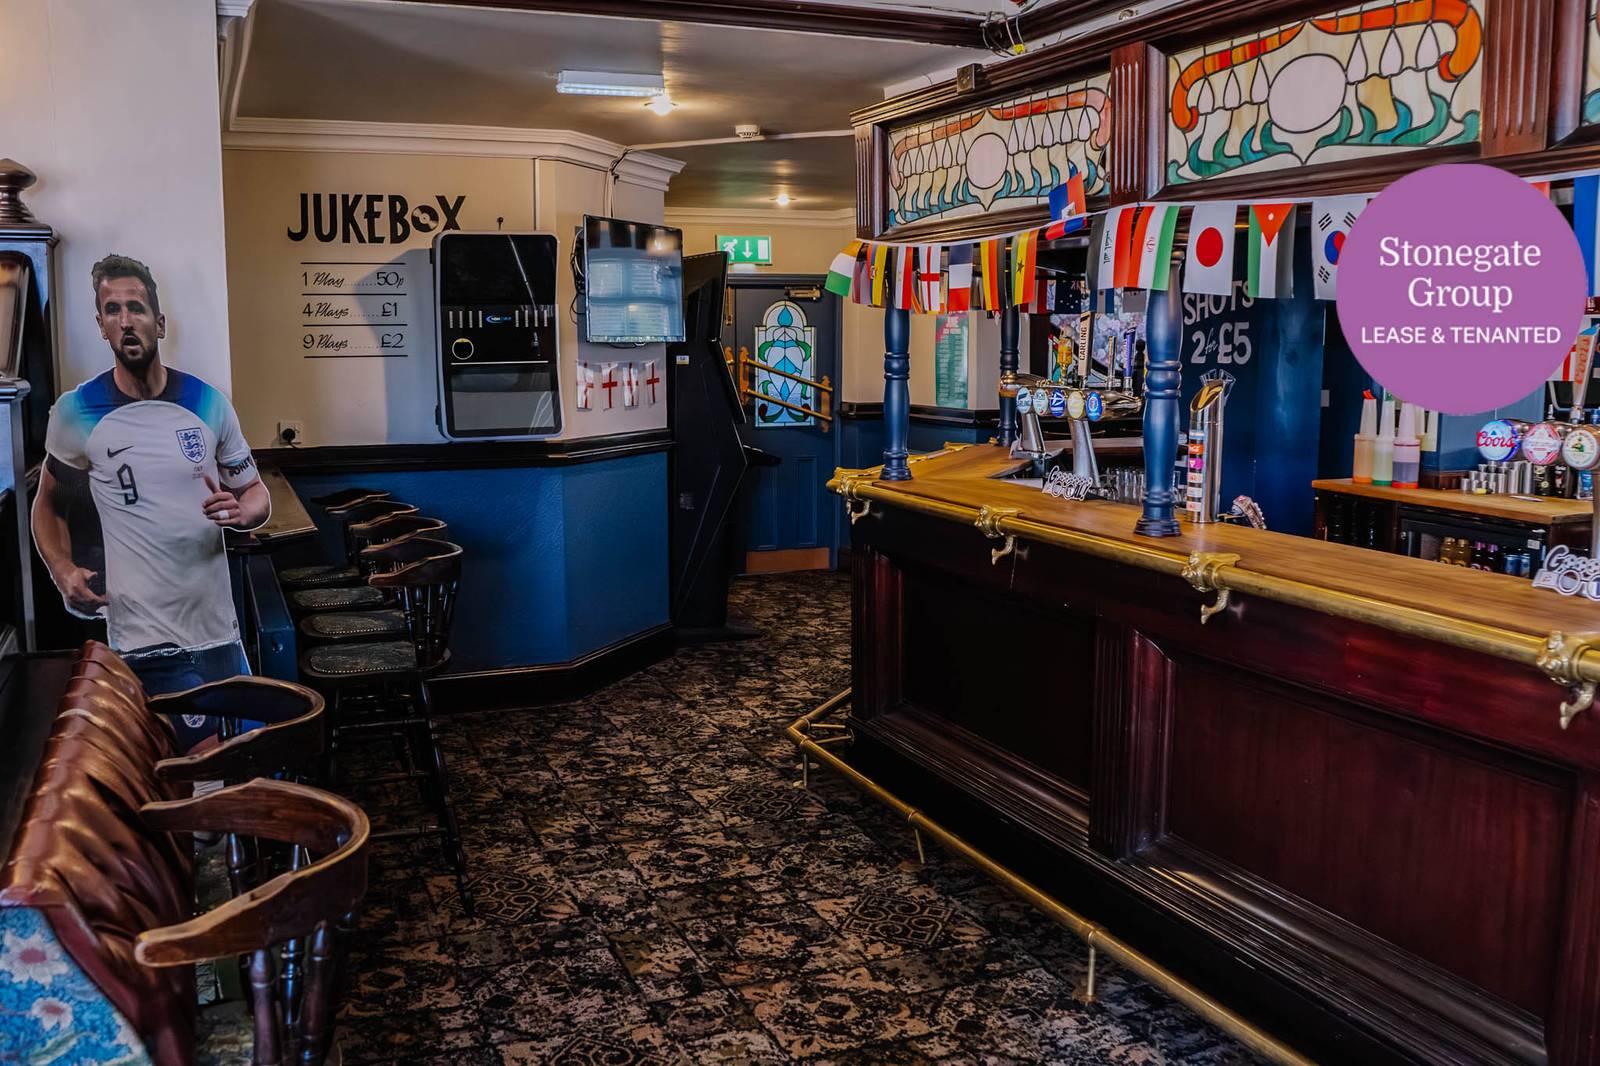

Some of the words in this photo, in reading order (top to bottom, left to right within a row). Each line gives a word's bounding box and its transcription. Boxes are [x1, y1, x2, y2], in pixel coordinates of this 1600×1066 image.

[287, 193, 466, 244] JUKEBOX
[302, 271, 309, 286] 1
[312, 271, 345, 288] Play
[376, 271, 404, 289] 50p
[302, 302, 313, 317] 4
[314, 302, 349, 319] Plays
[381, 302, 398, 317] £1
[1183, 280, 1254, 325] SHOTS
[303, 333, 315, 349] 9
[316, 334, 348, 351] Plays
[381, 333, 405, 349] £2
[1080, 327, 1088, 361] CARLING
[1190, 331, 1206, 364] 2
[1217, 322, 1252, 365] £5
[1475, 431, 1517, 448] Coors
[116, 463, 139, 505] 9
